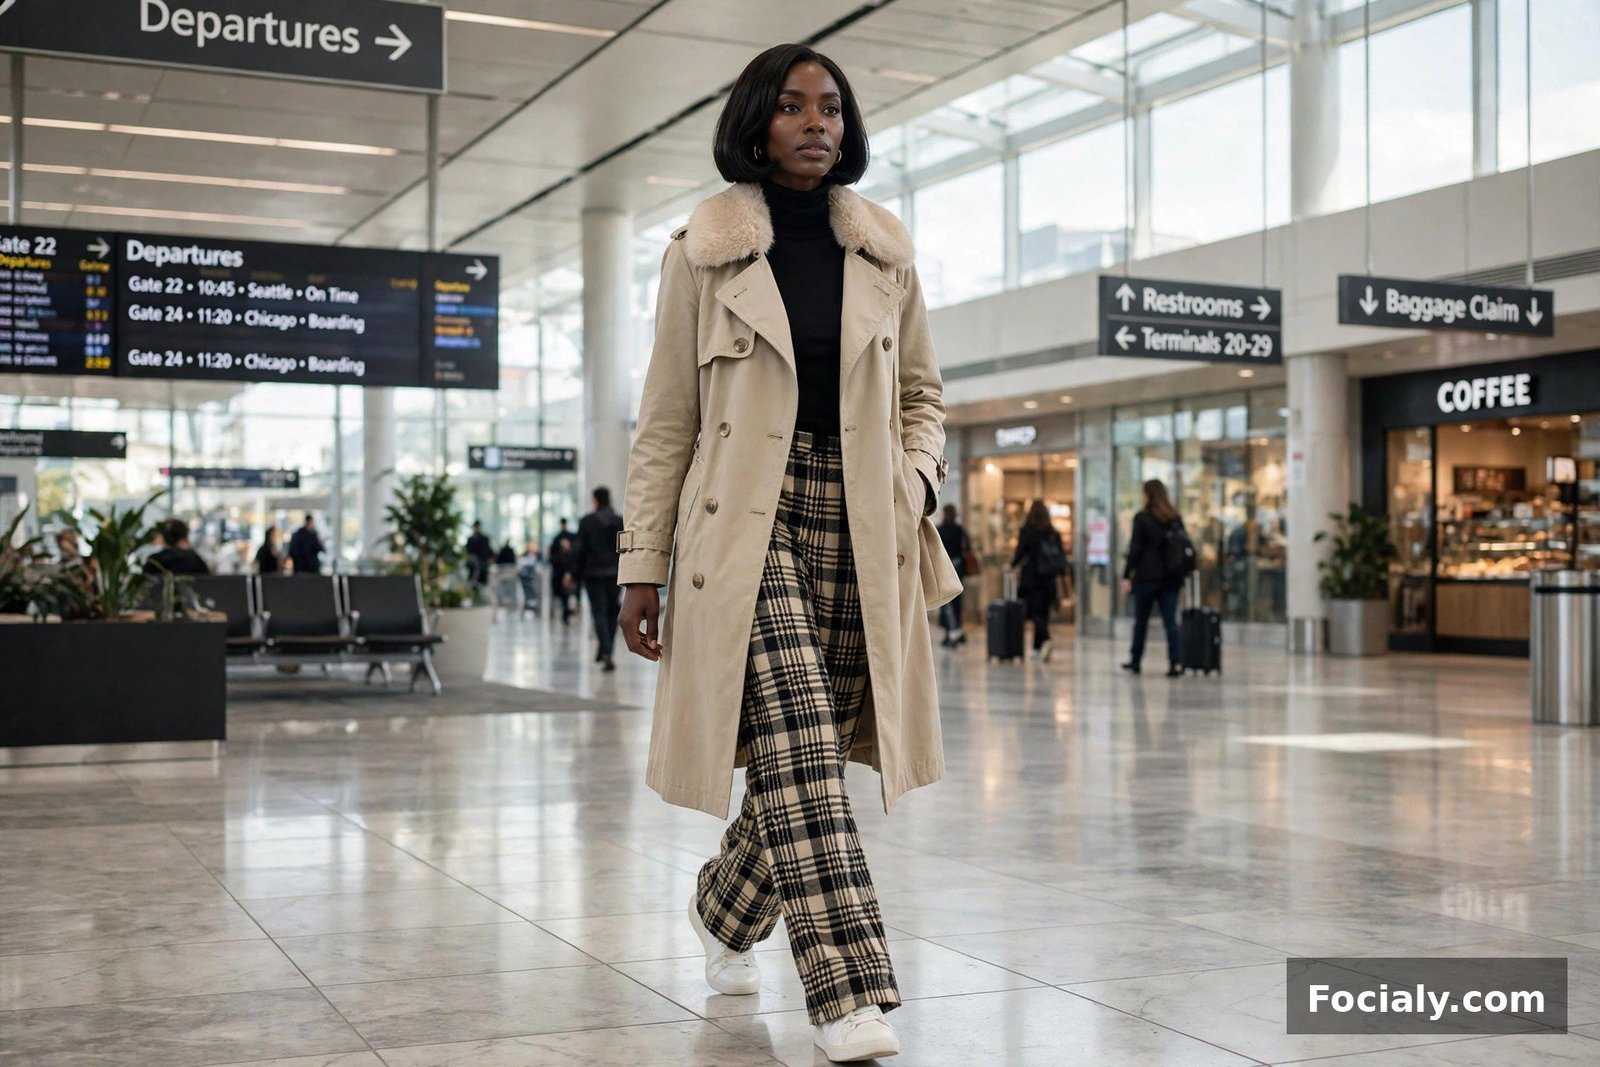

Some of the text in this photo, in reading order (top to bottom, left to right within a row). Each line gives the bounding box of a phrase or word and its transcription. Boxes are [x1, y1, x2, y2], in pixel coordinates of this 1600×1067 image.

[139, 0, 361, 54] Departures
[0, 236, 57, 256] ate 22
[126, 239, 243, 268] Departures
[128, 276, 360, 305] Gate 22 10:45 Seattle On Time
[1142, 286, 1244, 319] Restrooms
[1385, 287, 1520, 325] Baggage Claim
[128, 304, 366, 335] Gate 24 11:20 Chicago Boarding
[1140, 326, 1274, 358] Terminals 20-29
[128, 348, 366, 377] Gate 24 11:20 Chicago Boarding
[1436, 372, 1532, 414] COFFEE
